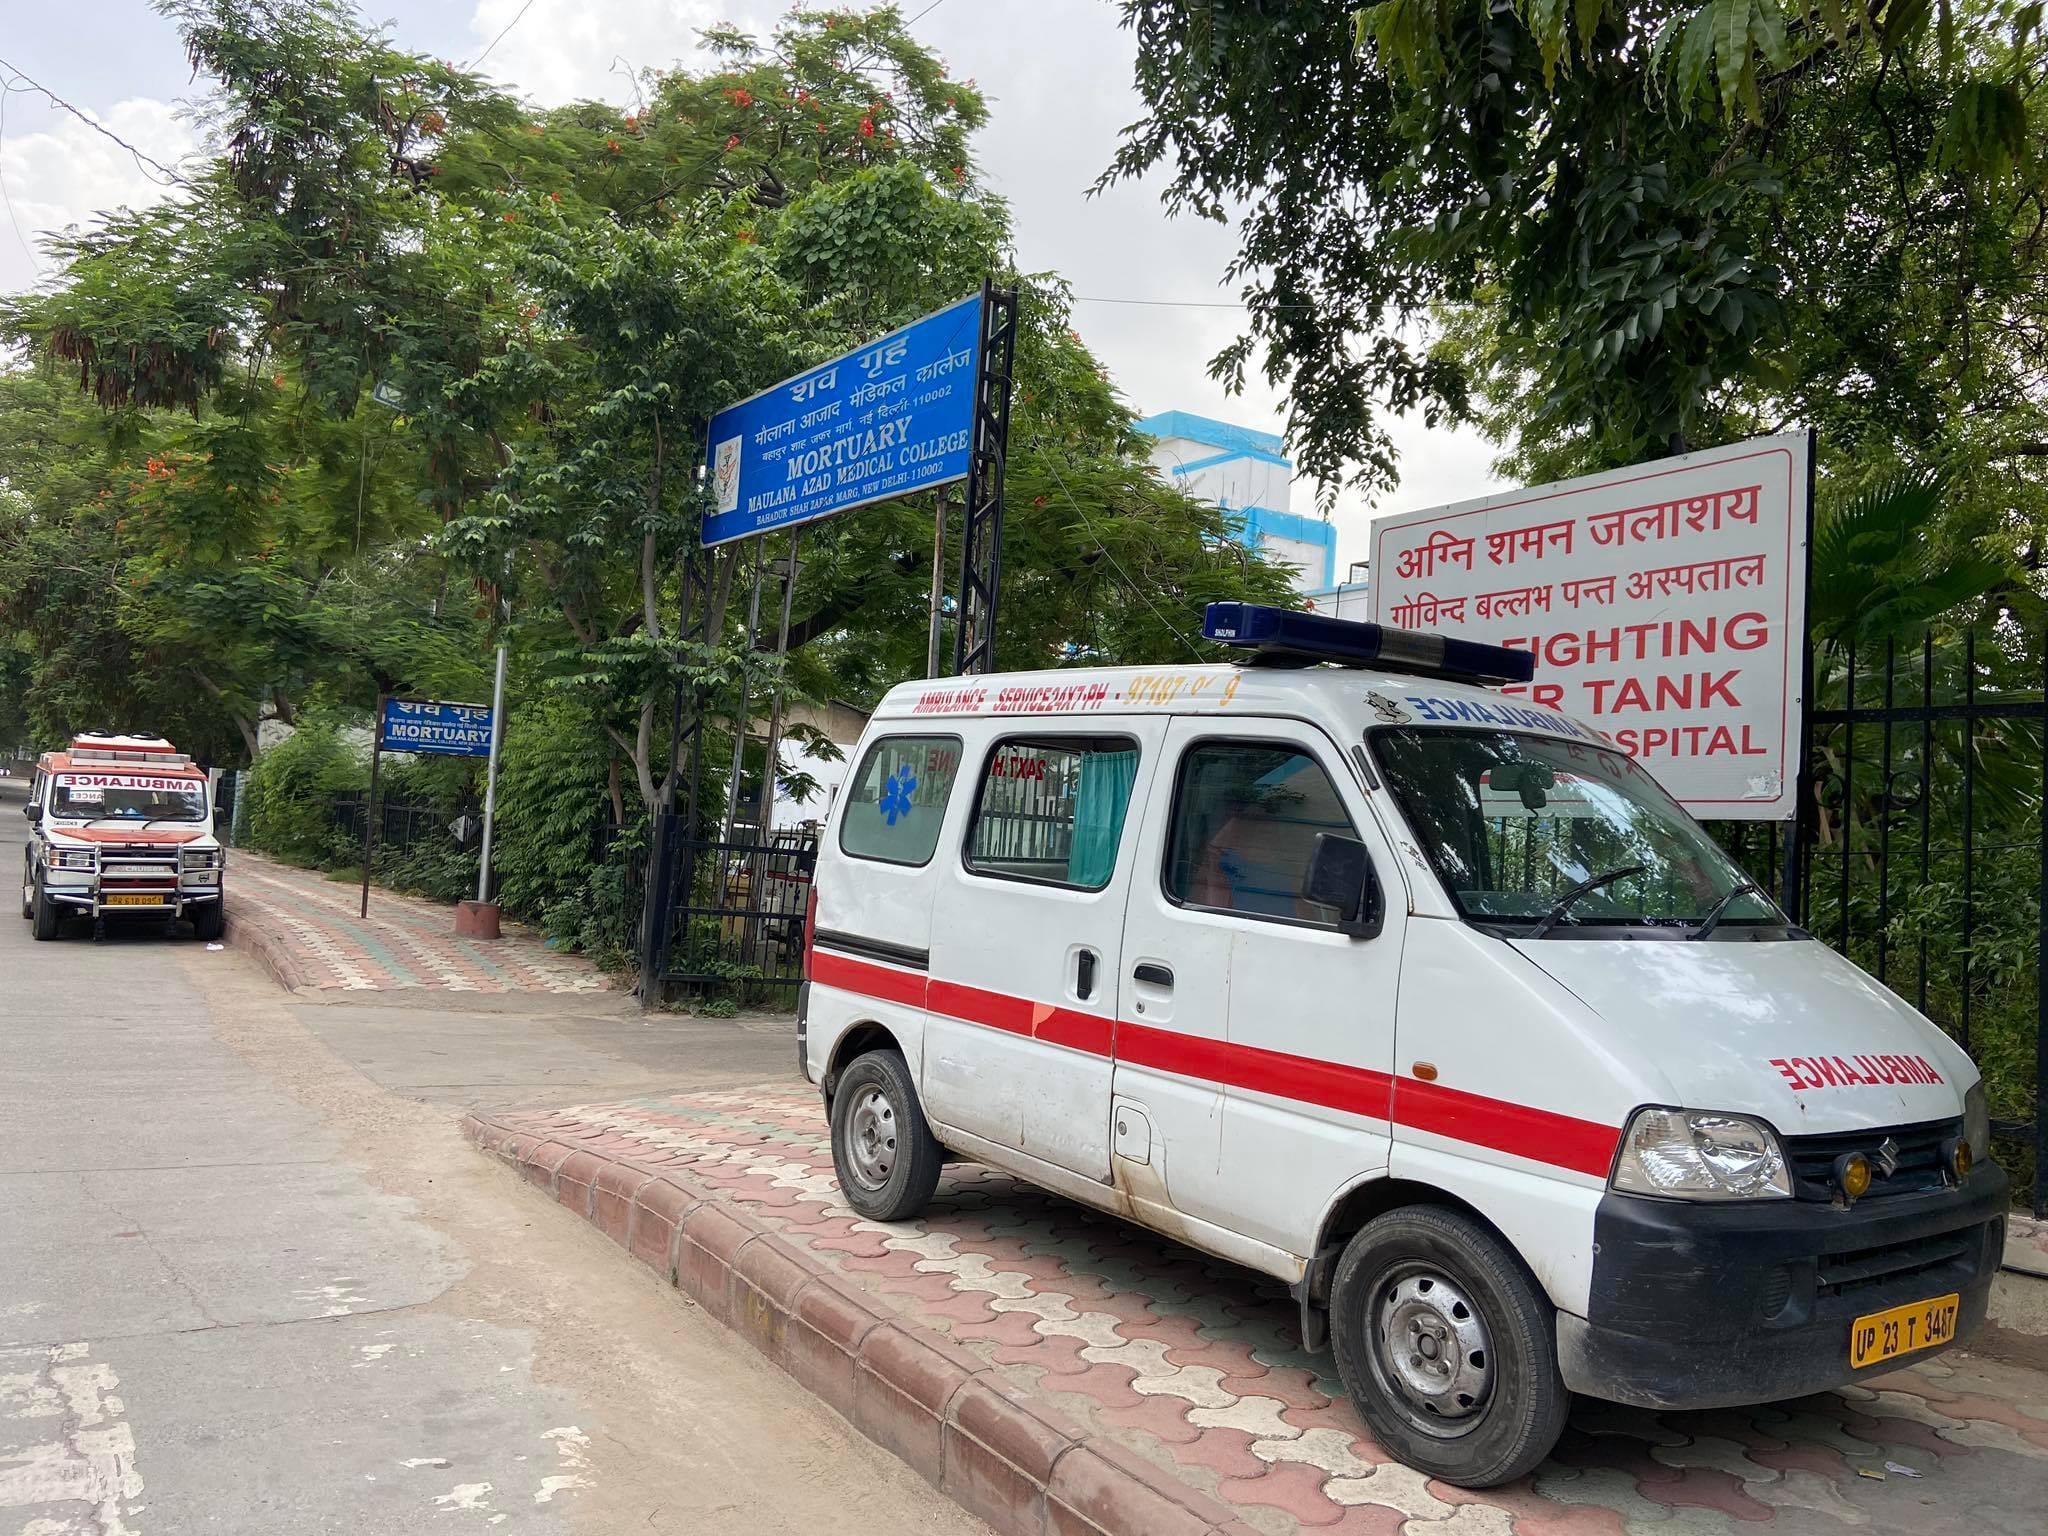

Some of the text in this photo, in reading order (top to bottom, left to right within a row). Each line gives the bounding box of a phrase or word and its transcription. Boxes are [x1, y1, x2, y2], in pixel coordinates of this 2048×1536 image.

[789, 336, 910, 402] शव गृह
[755, 418, 796, 446] मौलाना
[850, 374, 907, 408] मेडिकल
[762, 446, 787, 461] बहादुर
[791, 438, 807, 452] शाह
[859, 411, 874, 425] नई
[748, 429, 969, 513] MAULANA AZAD MEDICAL COLLEGE
[786, 415, 912, 481] MORTUARY
[757, 507, 788, 525] BAHADUR
[790, 501, 809, 516] SHAH
[862, 482, 879, 495] NEW
[1396, 484, 1762, 579] अग्नि शमन जलाशय
[1390, 553, 1767, 630] गोविन्द बल्लभ पन्त अस्पताल
[397, 701, 490, 723] शव गृह
[912, 687, 988, 713] AMBULANCE
[1583, 668, 1742, 715] TANK
[391, 724, 489, 742] MORTUARY
[1856, 1306, 1955, 1362] UP 23 T 3487
